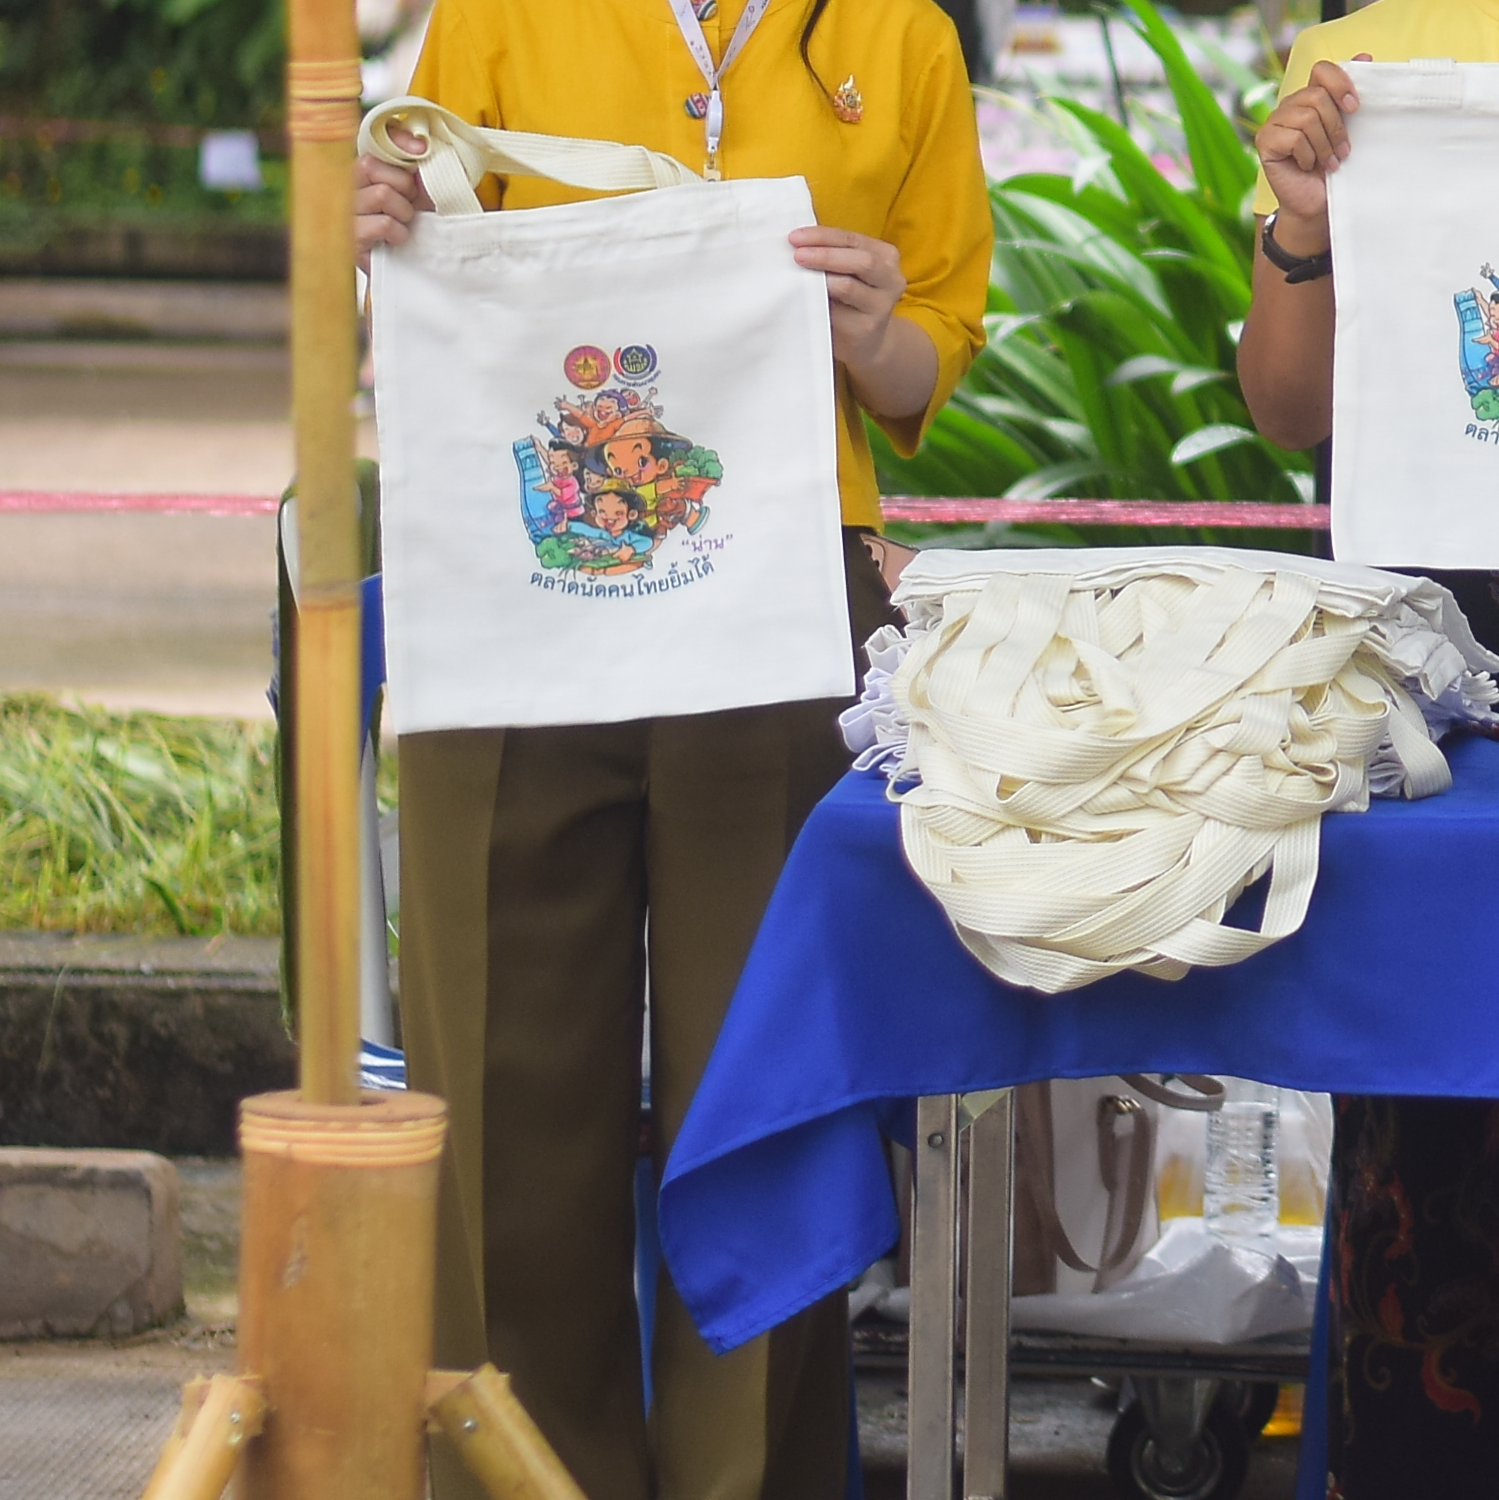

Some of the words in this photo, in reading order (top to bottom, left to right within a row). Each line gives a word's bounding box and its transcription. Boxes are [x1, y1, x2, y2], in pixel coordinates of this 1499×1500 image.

[682, 531, 734, 553] “น่าน”
[530, 553, 715, 598] ตลาดนัดคนไทยยิ้มได้
